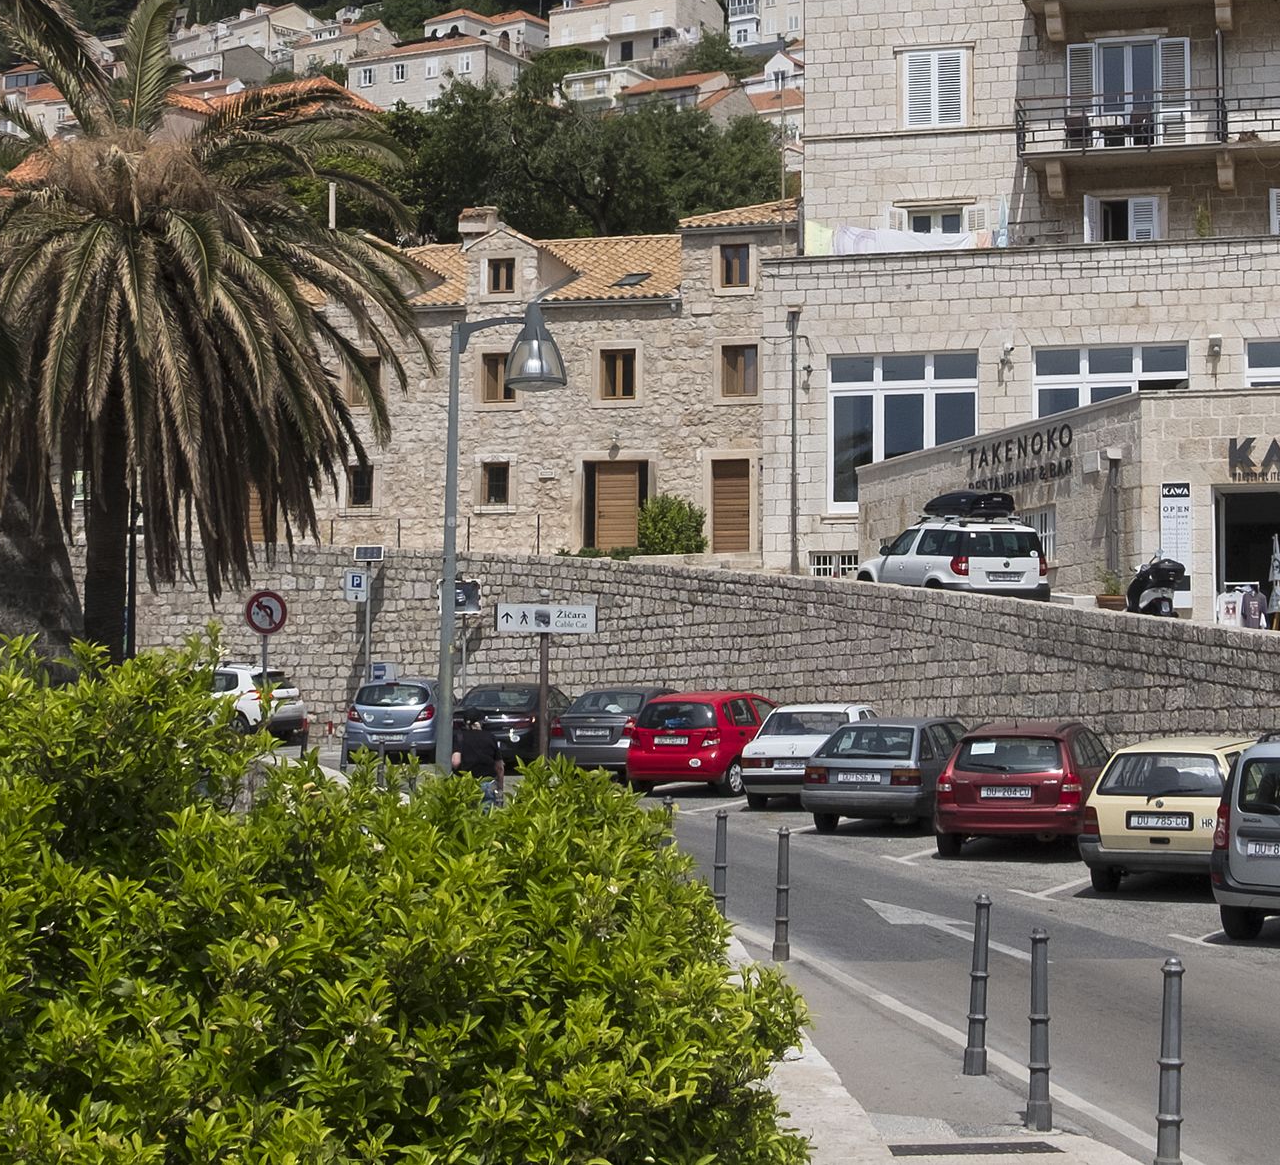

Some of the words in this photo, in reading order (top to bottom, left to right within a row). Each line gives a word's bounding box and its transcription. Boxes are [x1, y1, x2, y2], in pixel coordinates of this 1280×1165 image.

[968, 423, 1073, 470] TAKENOKO
[1050, 458, 1073, 480] BAR
[1163, 487, 1189, 496] KAWA
[1162, 505, 1190, 513] OPEN
[575, 620, 588, 629] Car
[1137, 815, 1149, 825] DU
[1201, 818, 1214, 828] HR
[1254, 842, 1267, 854] DU
